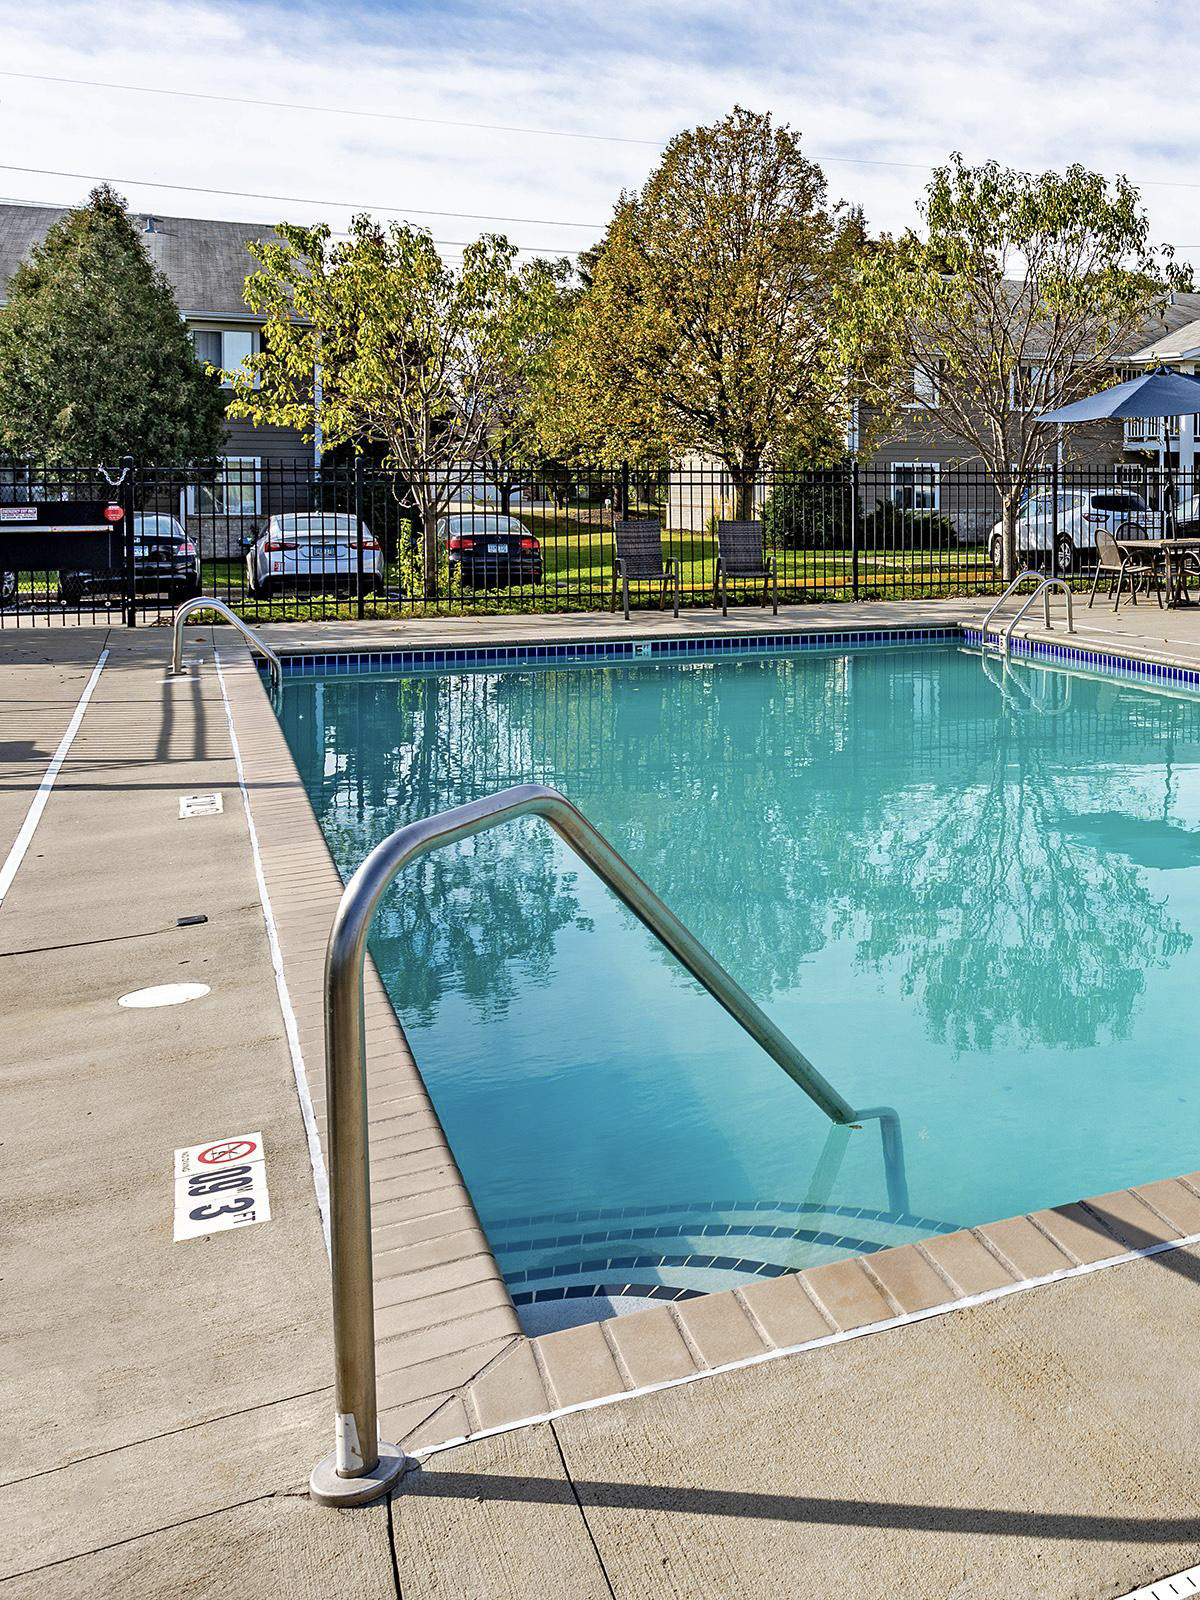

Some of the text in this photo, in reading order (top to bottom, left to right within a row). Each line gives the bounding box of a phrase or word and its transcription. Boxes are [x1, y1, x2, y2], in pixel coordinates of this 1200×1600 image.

[188, 1165, 253, 1197] 0.9
[189, 1197, 255, 1221] 3
[233, 1211, 256, 1224] FT
